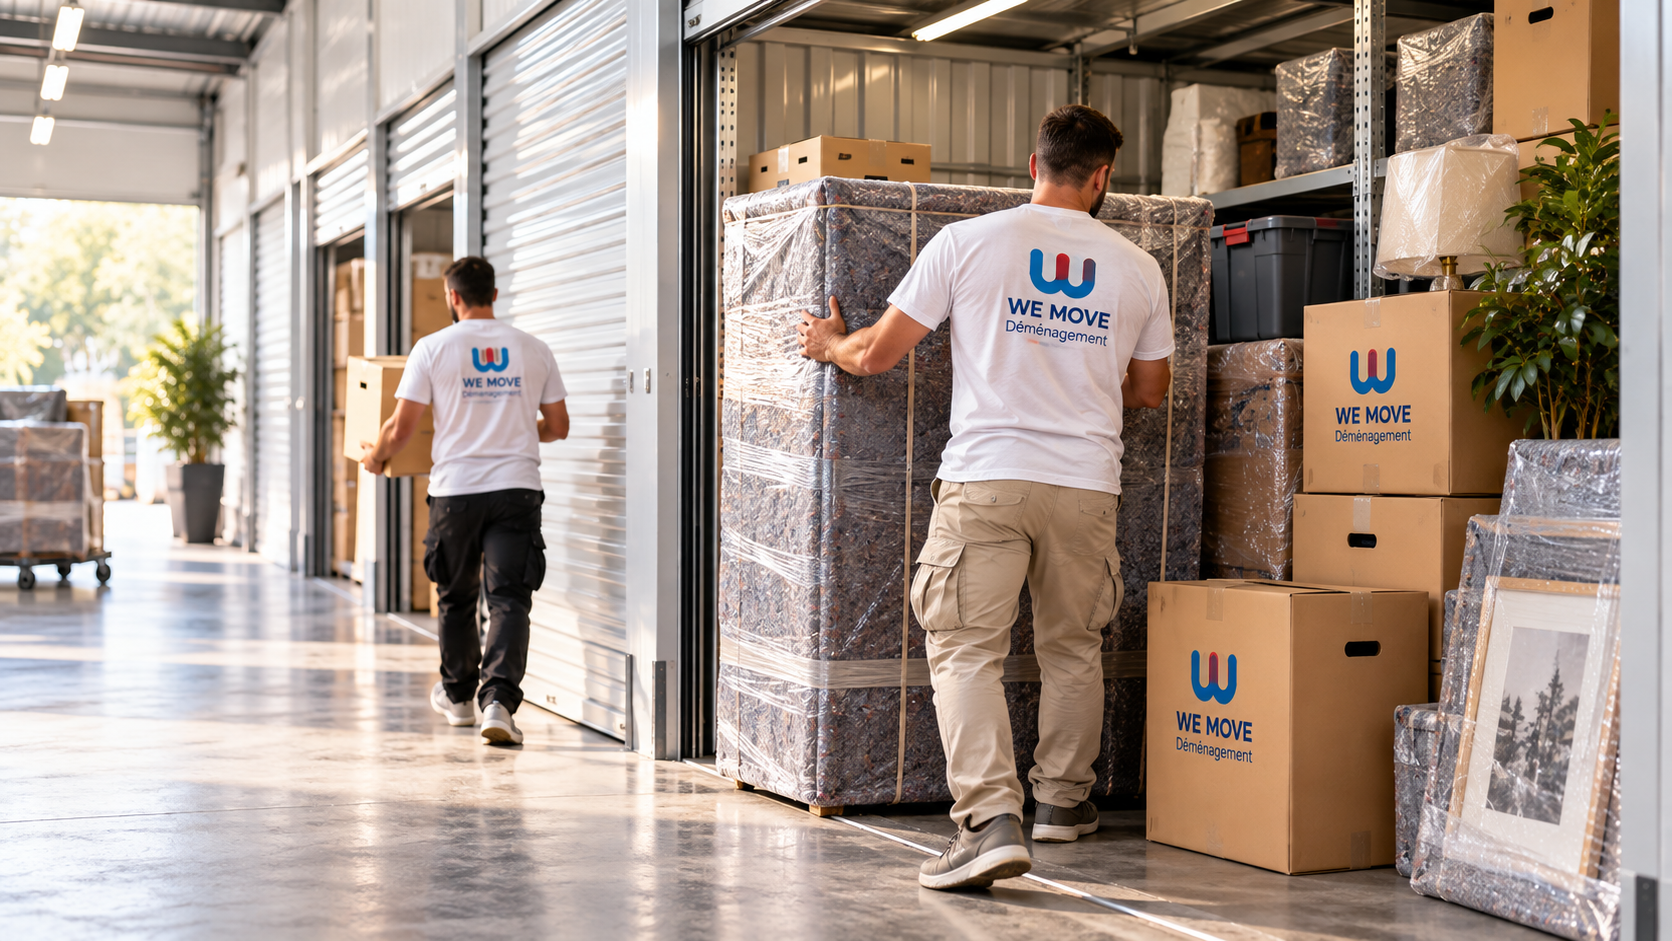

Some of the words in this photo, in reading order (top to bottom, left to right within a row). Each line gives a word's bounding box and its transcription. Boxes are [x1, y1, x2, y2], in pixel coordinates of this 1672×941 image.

[1007, 297, 1044, 318] WE
[1049, 304, 1111, 330] MOVE
[1005, 320, 1108, 347] Déménagement
[462, 377, 483, 388] WE
[486, 376, 522, 388] MOVE
[1335, 406, 1361, 425] WE
[1365, 404, 1412, 424] MOVE
[1335, 429, 1412, 445] Déménagement
[1176, 710, 1201, 734] WE
[1206, 715, 1253, 743] MOVE
[1176, 736, 1253, 764] Déménagement
